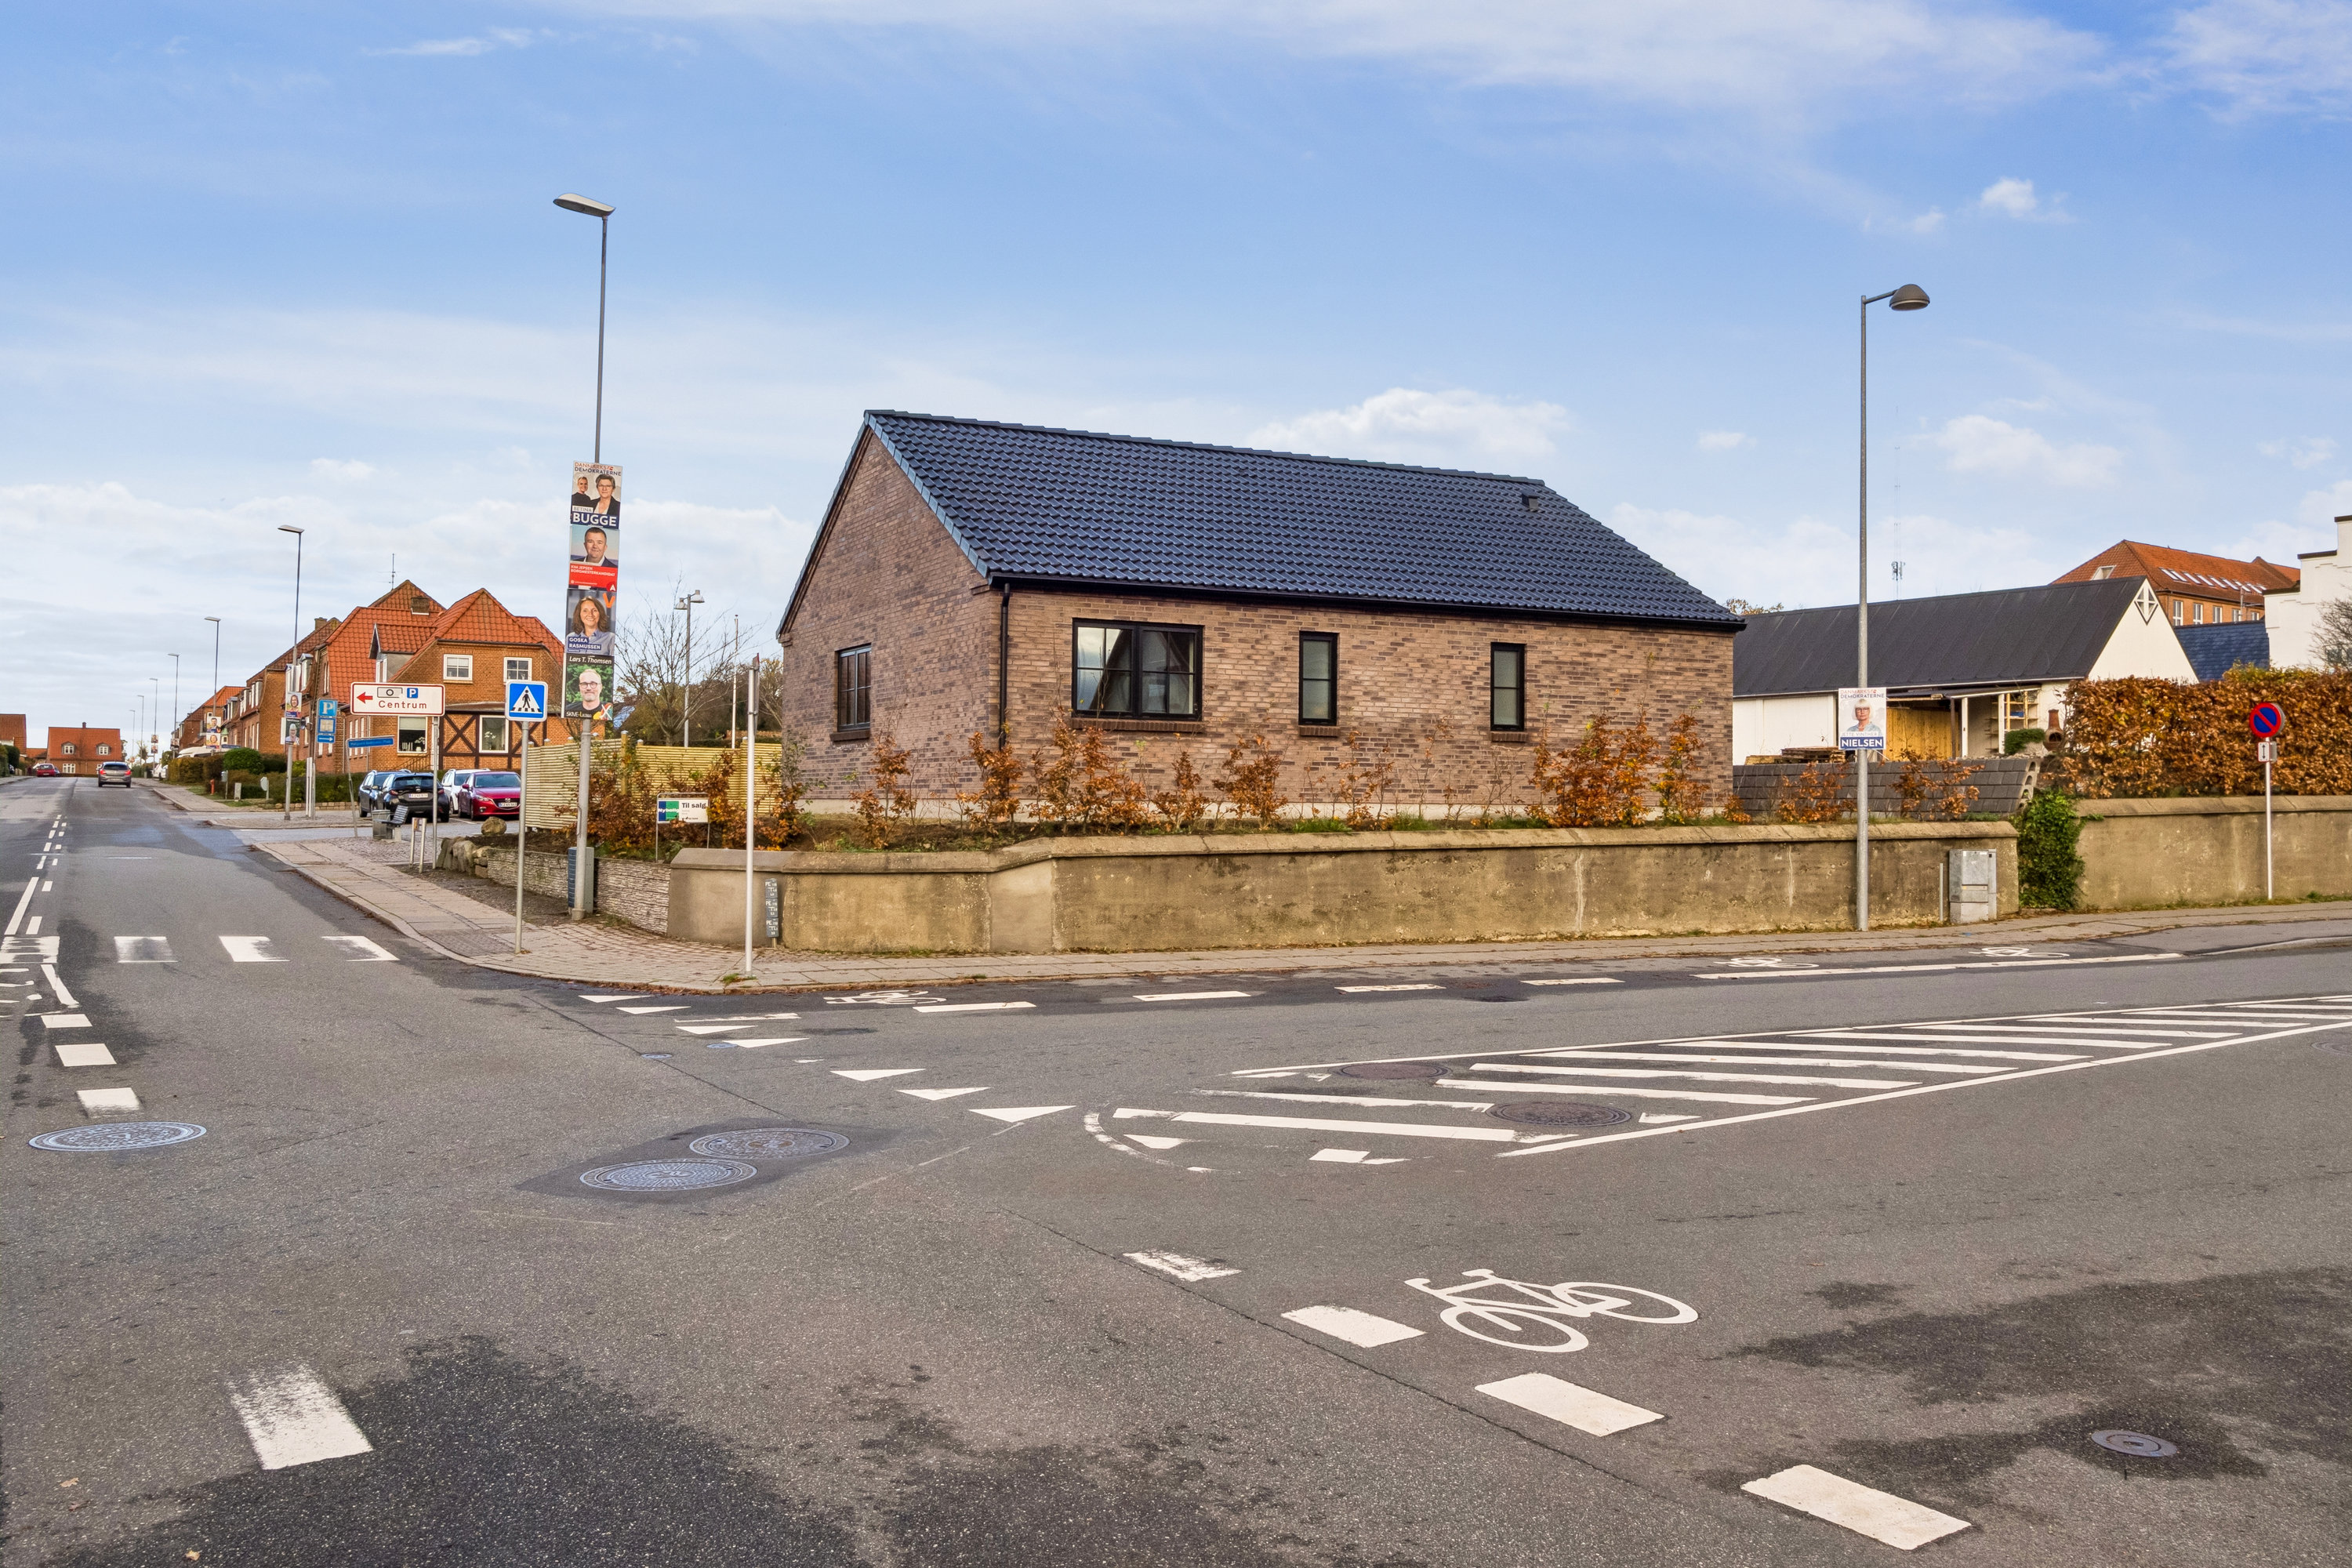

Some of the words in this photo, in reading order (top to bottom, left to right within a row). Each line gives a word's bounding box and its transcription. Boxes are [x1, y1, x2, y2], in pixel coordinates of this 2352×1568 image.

[574, 466, 622, 477] DEMOKRATERNE
[573, 513, 617, 526] BUGGE
[603, 593, 615, 608] V
[408, 688, 416, 698] P
[321, 702, 333, 714] P
[378, 700, 427, 710] Centrum
